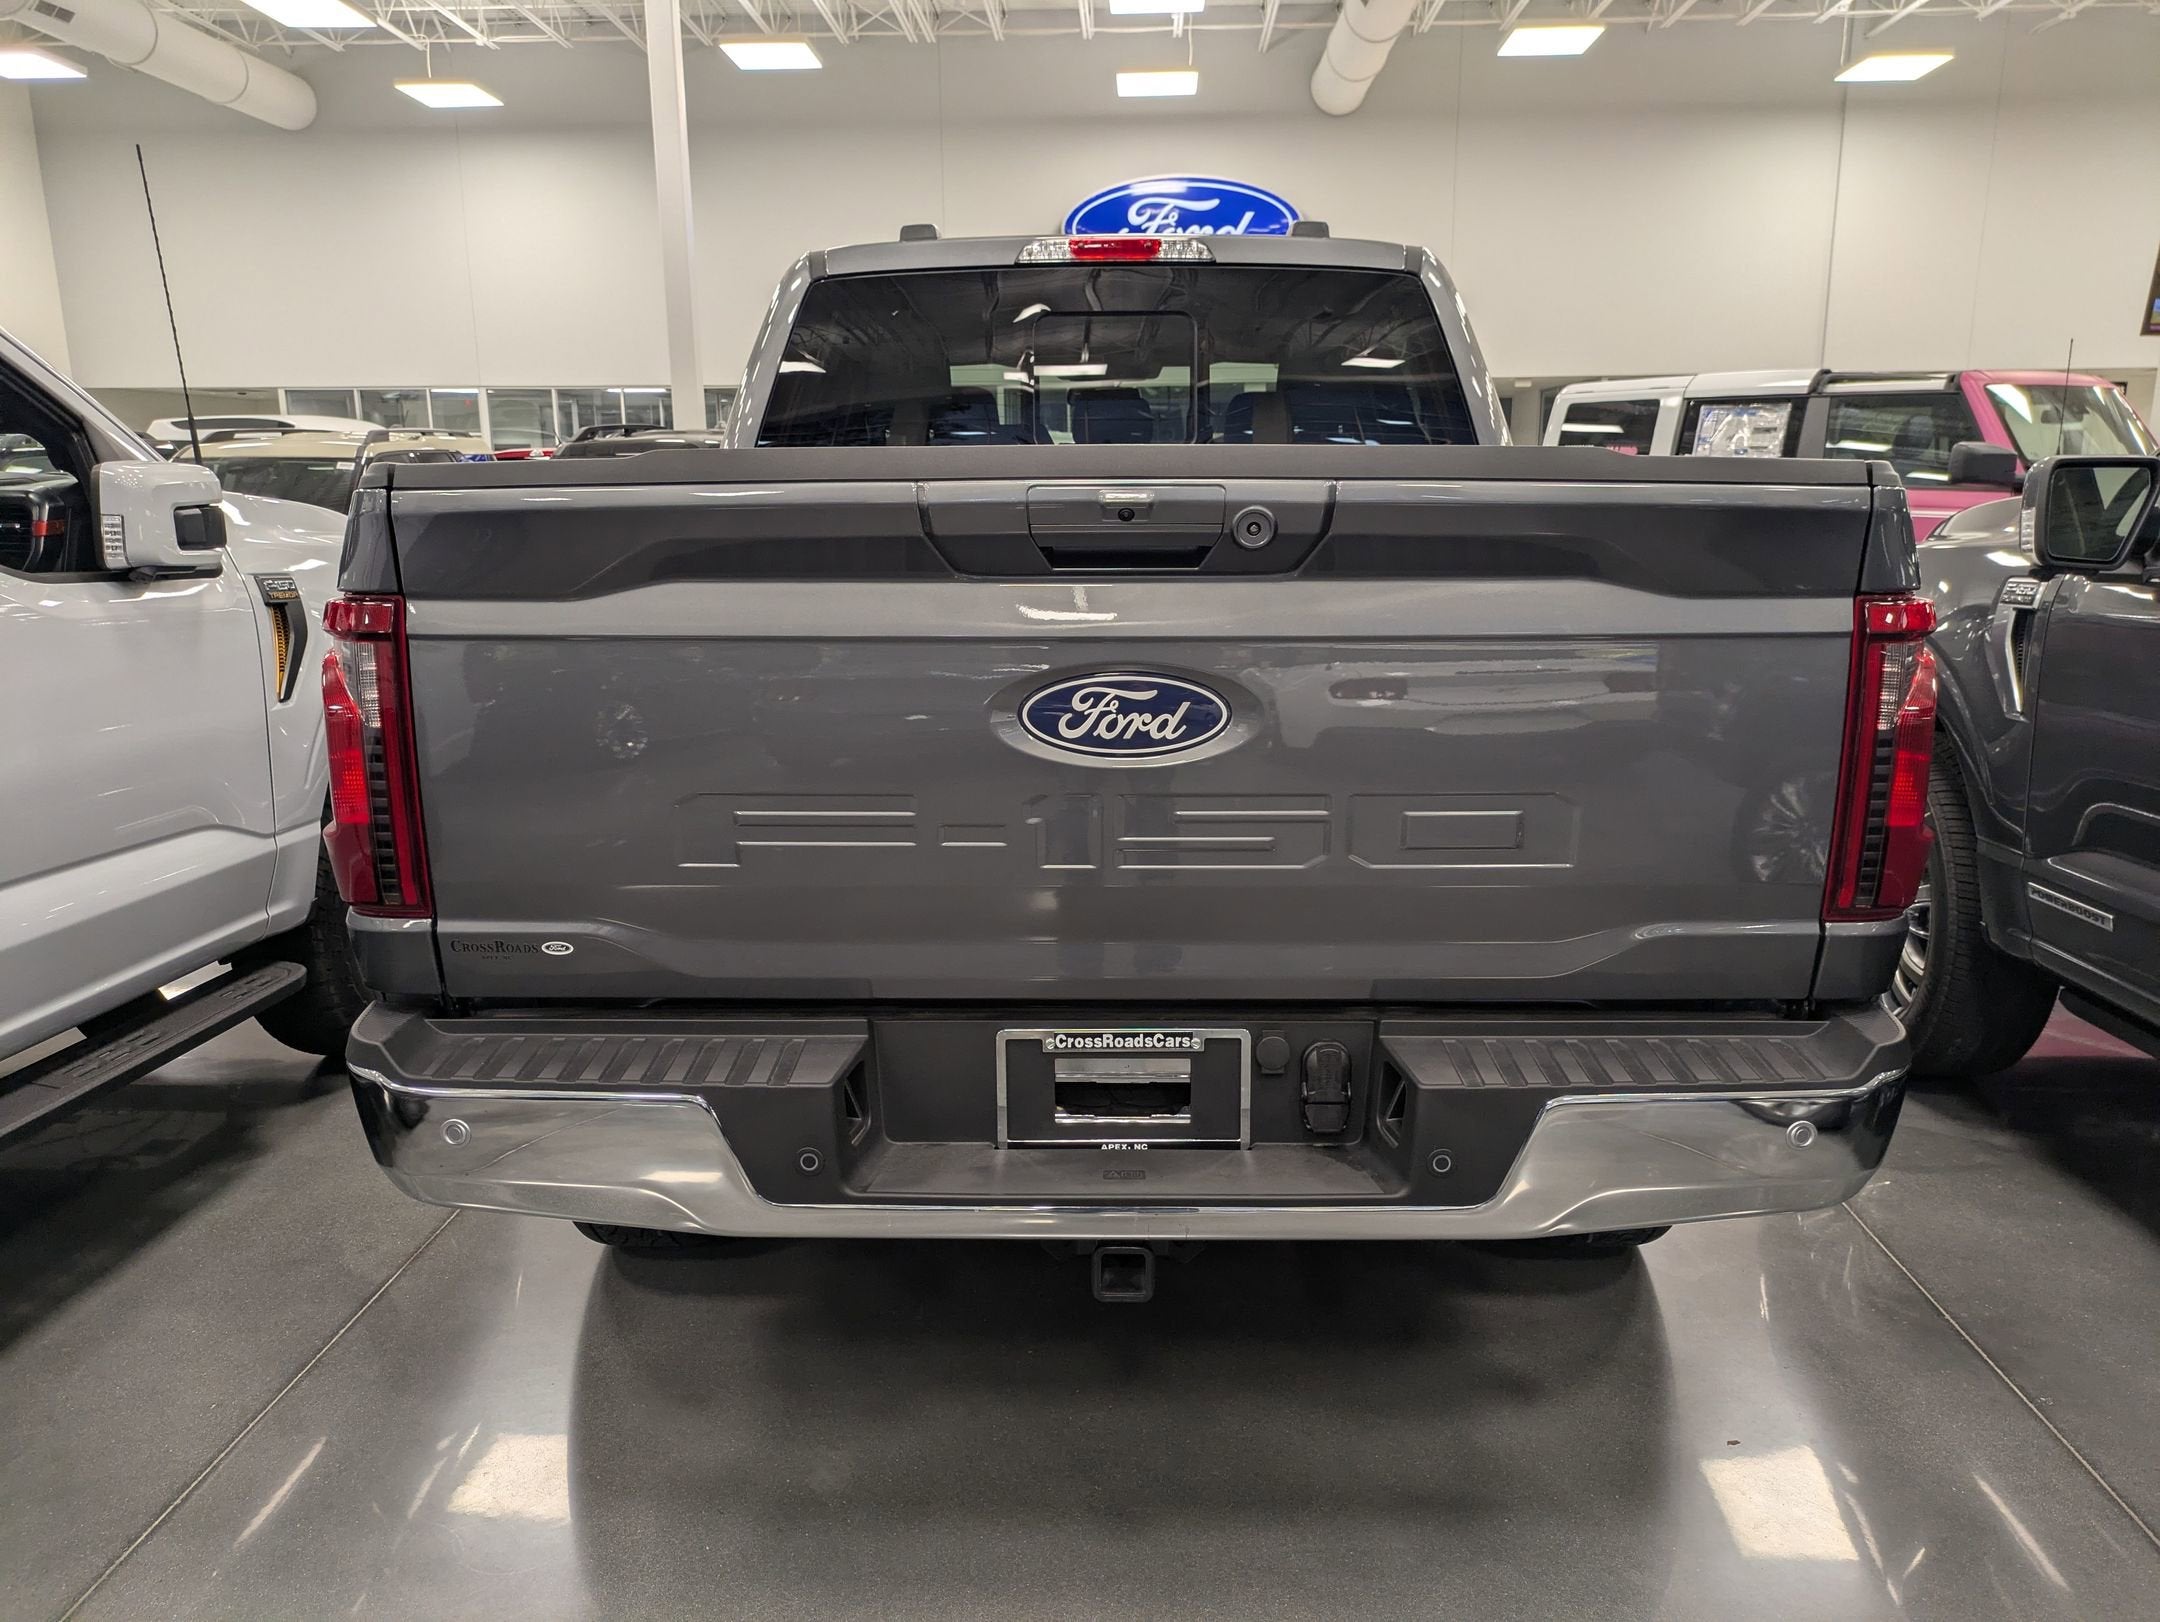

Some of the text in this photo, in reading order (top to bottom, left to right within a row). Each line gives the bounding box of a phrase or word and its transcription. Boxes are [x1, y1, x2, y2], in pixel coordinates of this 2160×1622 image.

[1058, 686, 1191, 739] Ford
[672, 793, 1579, 870] F-150
[1055, 1033, 1191, 1049] CrossRoadsCars
